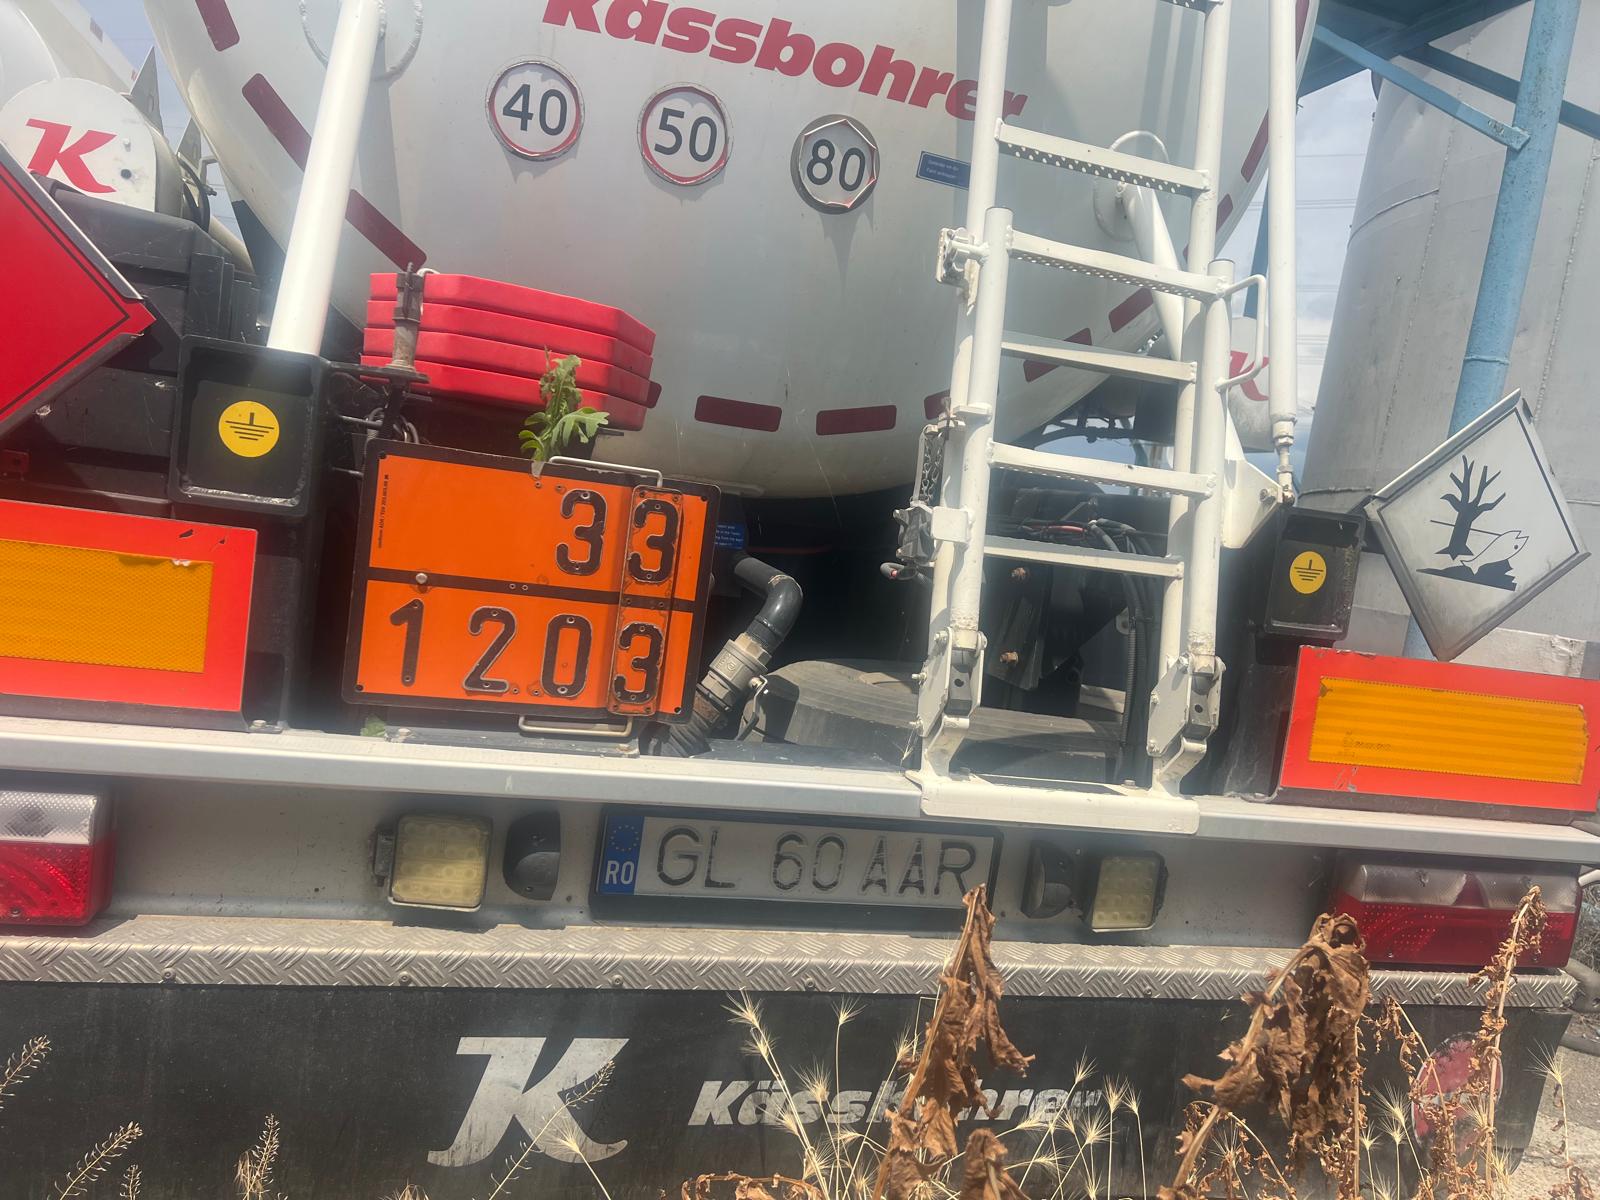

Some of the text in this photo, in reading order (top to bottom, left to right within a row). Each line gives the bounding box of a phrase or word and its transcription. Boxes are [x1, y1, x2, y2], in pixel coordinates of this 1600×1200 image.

[502, 83, 569, 137] 40
[653, 107, 718, 163] 50
[25, 118, 118, 194] K
[806, 138, 866, 192] 80
[389, 598, 665, 704] 1203
[604, 859, 635, 885] RO
[656, 824, 977, 897] GL 60 AAR
